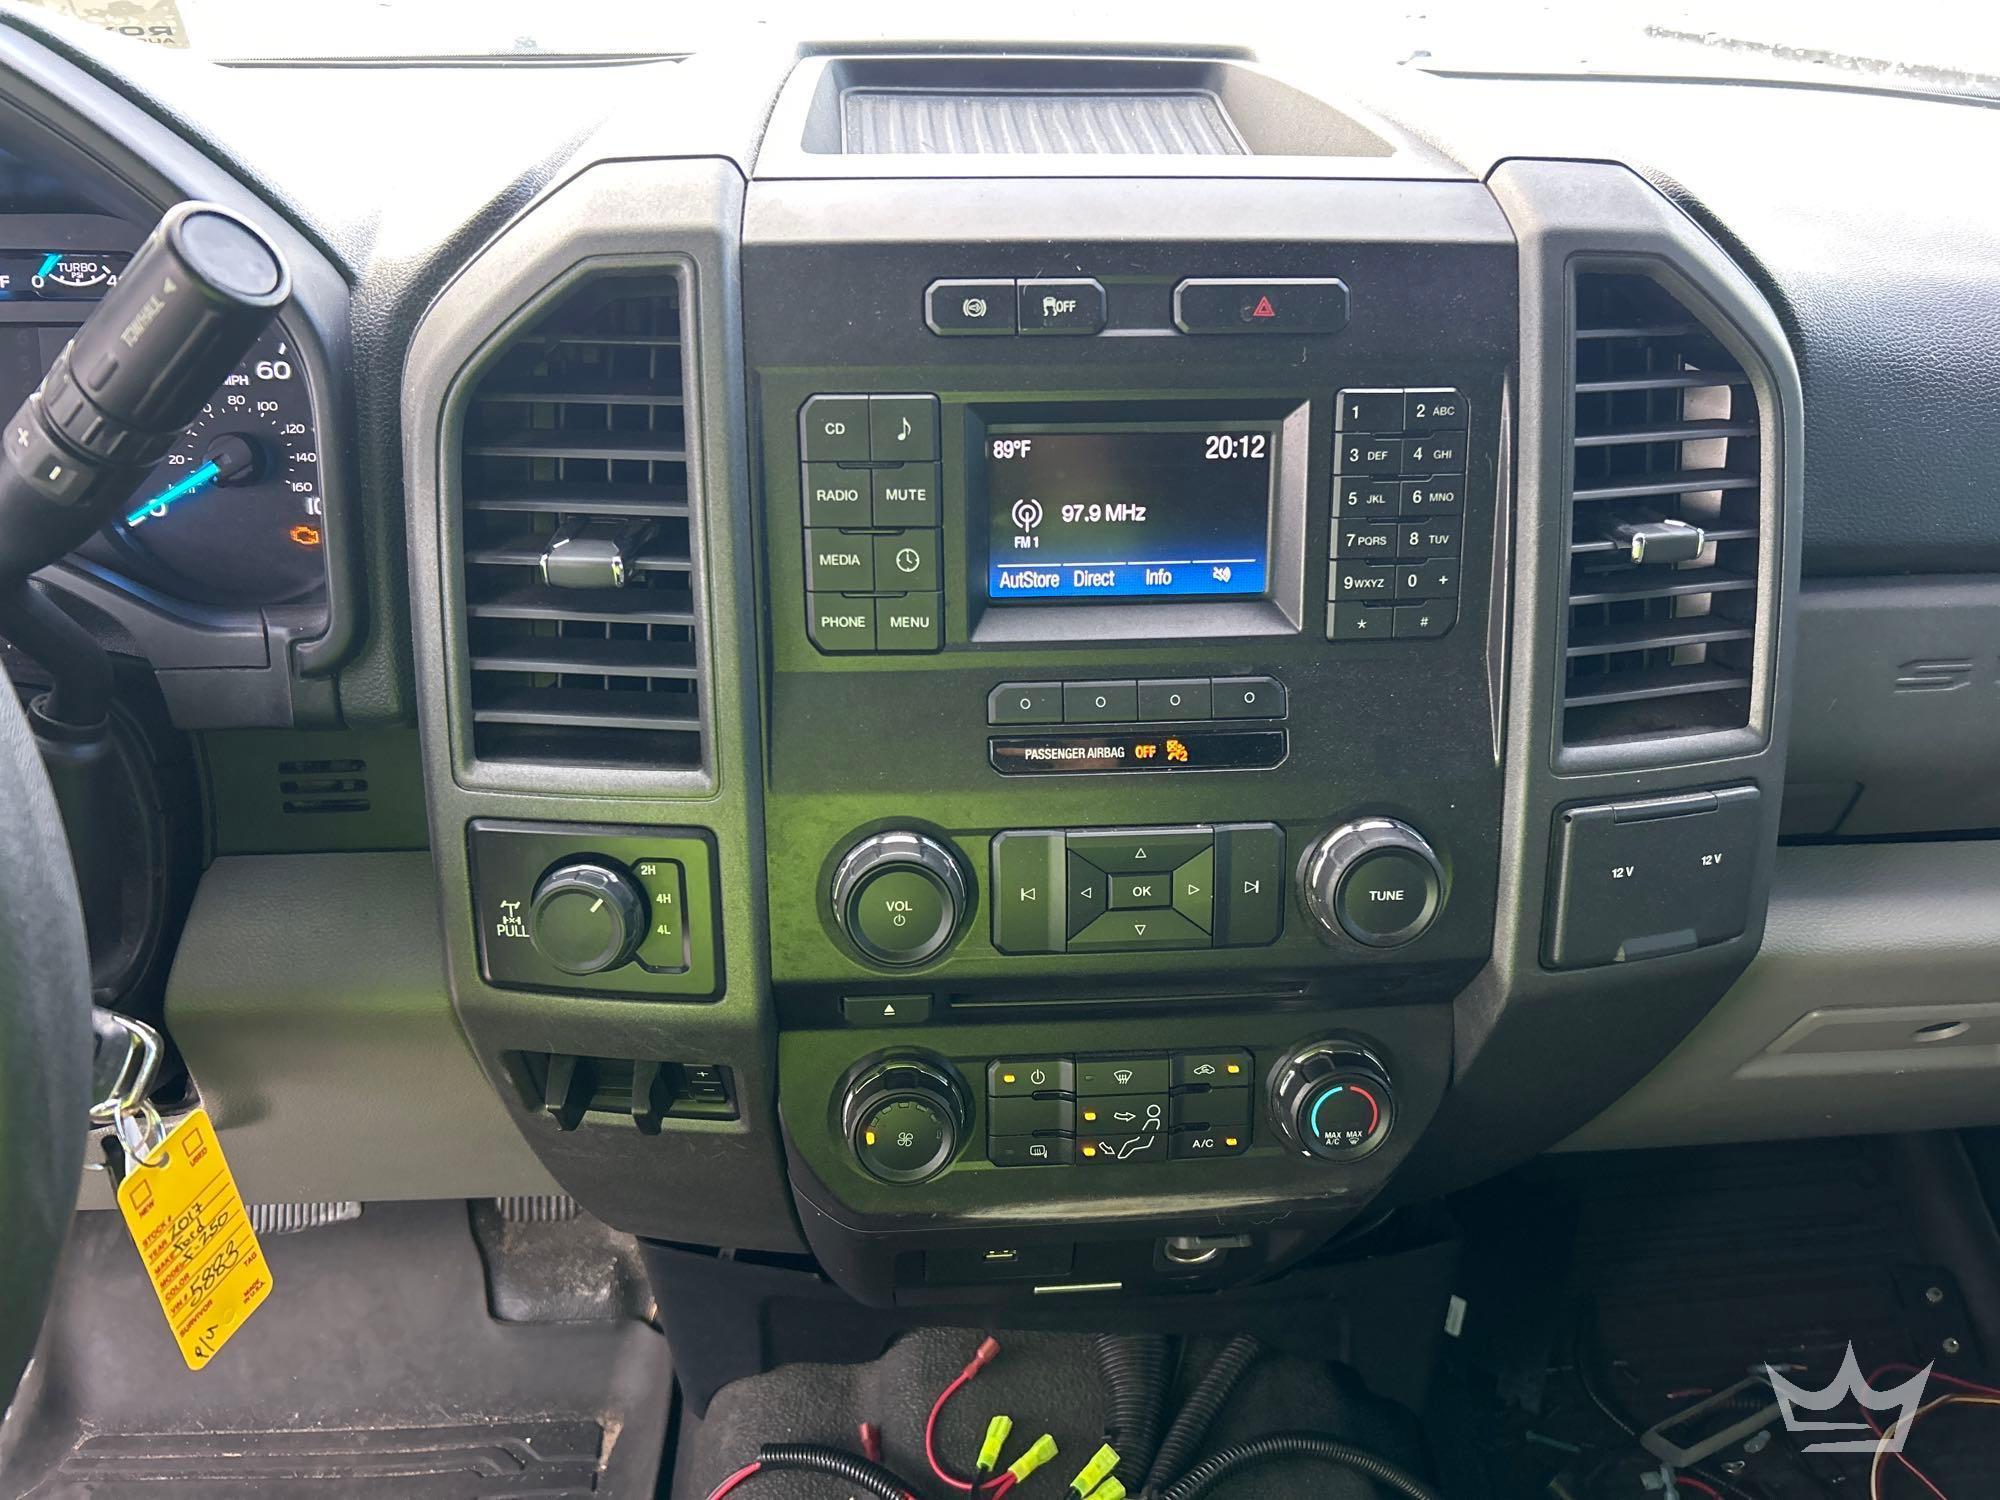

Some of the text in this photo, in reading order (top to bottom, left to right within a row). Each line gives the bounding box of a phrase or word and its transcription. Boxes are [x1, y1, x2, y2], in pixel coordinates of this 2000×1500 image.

[57, 263, 98, 273] TURBO
[31, 275, 45, 288] 0
[106, 275, 119, 287] 4
[1056, 300, 1076, 313] OFF
[256, 361, 291, 380] 60
[227, 395, 246, 405] 80
[257, 401, 279, 412] 100
[1352, 405, 1359, 419] 1
[1416, 404, 1455, 418] 2 ABC
[286, 424, 306, 434] 120
[825, 423, 845, 435] CD
[993, 440, 1031, 459] 89°F
[1205, 435, 1265, 459] 20:12
[168, 454, 185, 465] 20
[296, 452, 317, 463] 140
[1349, 448, 1388, 462] 3 DEF
[1413, 447, 1452, 461] 4 GHI
[292, 482, 313, 492] 160
[816, 490, 858, 501] RADIO
[886, 489, 926, 501] MUTE
[1348, 492, 1386, 506] 5 JKL
[1412, 490, 1454, 504] 6 MNO
[1062, 503, 1147, 522] 97.9 MHz
[1014, 537, 1039, 548] FM 1
[1346, 534, 1387, 547] 7 PQRS
[1409, 531, 1450, 545] 8 TUV
[819, 554, 860, 566] MEDIA
[999, 571, 1060, 589] AutStore
[1073, 570, 1115, 587] Direct
[1145, 568, 1172, 585] Info
[1344, 576, 1385, 590] 9 WXYZ
[1408, 574, 1417, 587] 0
[821, 616, 866, 628] PHONE
[890, 616, 930, 628] MENU
[1420, 616, 1429, 627] #
[1025, 745, 1156, 760] PASSENGER AIRBAG OFF
[1701, 853, 1722, 866] 12 V
[640, 865, 656, 875] 2H
[1612, 866, 1634, 878] 12 V
[1132, 886, 1152, 897] OK
[1369, 890, 1404, 901] TUNE
[656, 894, 671, 904] 4H
[886, 900, 913, 912] VOL
[497, 924, 530, 937] PULL
[657, 925, 671, 935] 4L
[1192, 1139, 1214, 1148] A/C
[190, 1147, 208, 1167] USED
[168, 1203, 202, 1241] 2017
[142, 1222, 166, 1248] STOCK
[173, 1217, 205, 1252] Ford
[149, 1240, 168, 1259] YEAR
[155, 1252, 175, 1275] MAKE
[190, 1240, 238, 1307] 5883
[165, 1272, 190, 1301] COLOR
[180, 1252, 257, 1337] SURVIVOR TAG
[171, 1300, 183, 1313] VIN
